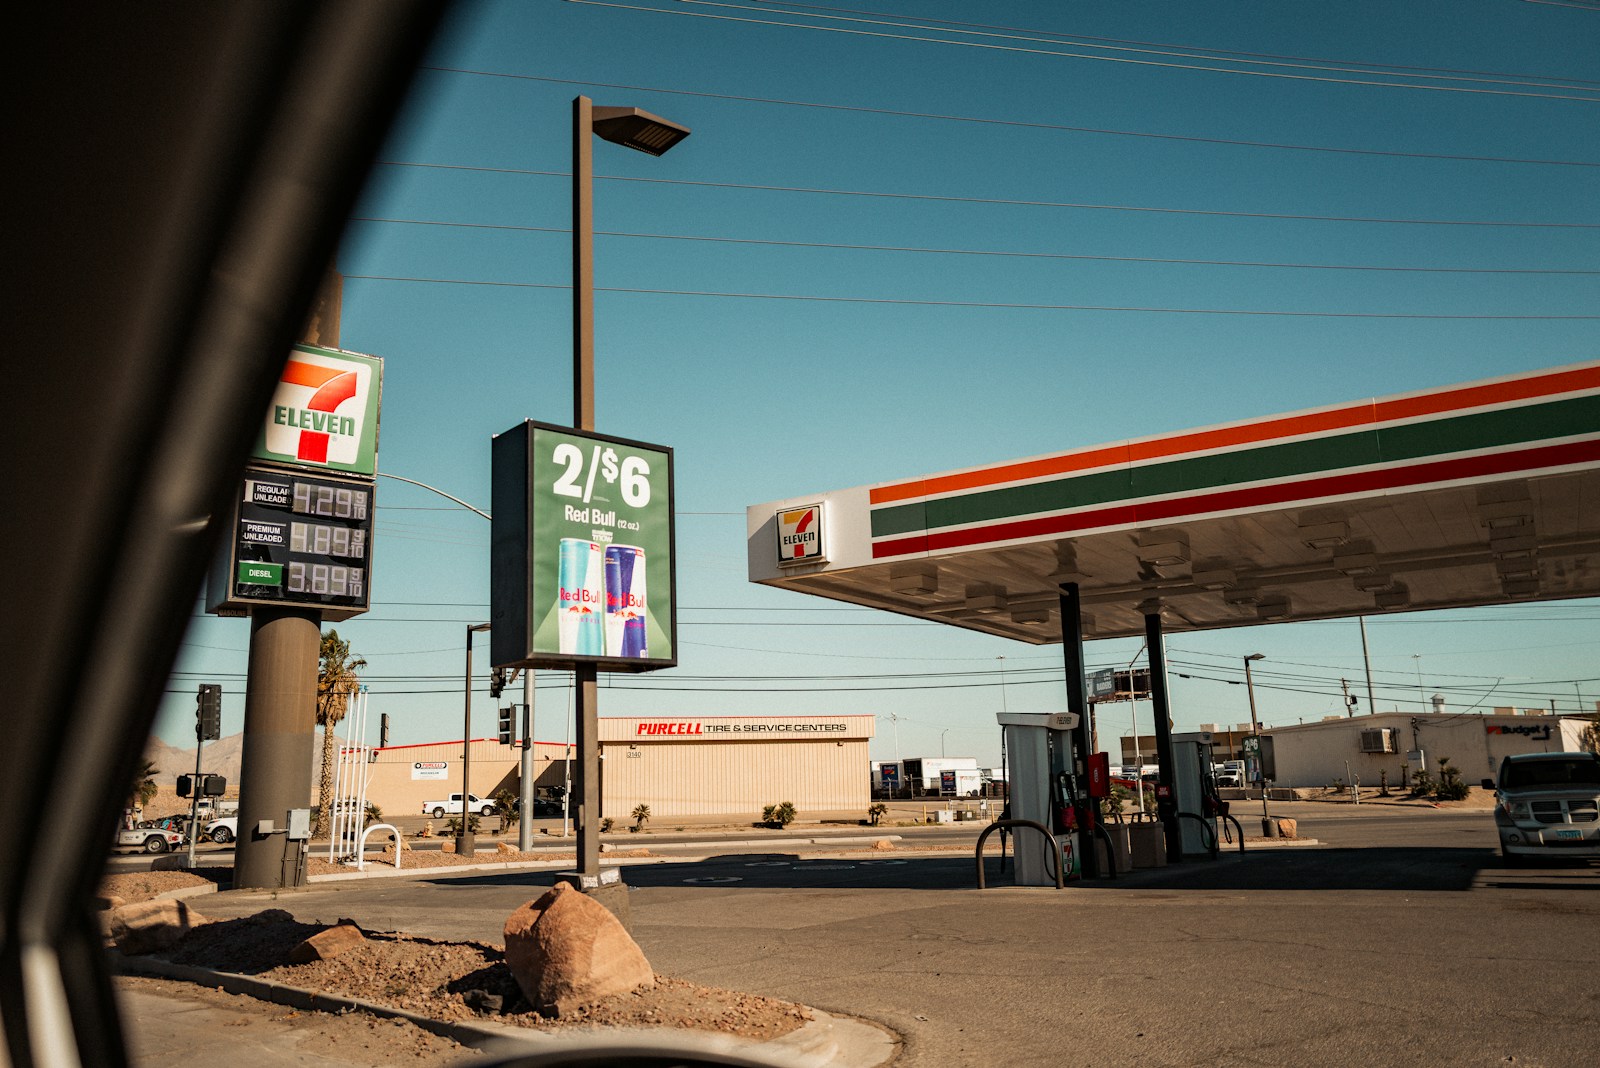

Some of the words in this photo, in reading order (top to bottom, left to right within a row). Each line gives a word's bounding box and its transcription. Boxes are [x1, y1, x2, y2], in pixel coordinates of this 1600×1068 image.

[564, 504, 589, 524] Red
[592, 508, 615, 528] Bull
[247, 524, 281, 534] PREMIUM
[244, 532, 283, 543] UNLEADED
[248, 569, 273, 578] DIESEL
[560, 587, 580, 601] Red
[637, 722, 703, 735] PURCELL
[705, 724, 731, 732] TIRE
[732, 724, 741, 732] &
[743, 724, 793, 732] SERVICE
[794, 723, 847, 732] CENTERS
[1502, 725, 1541, 736] Budget
